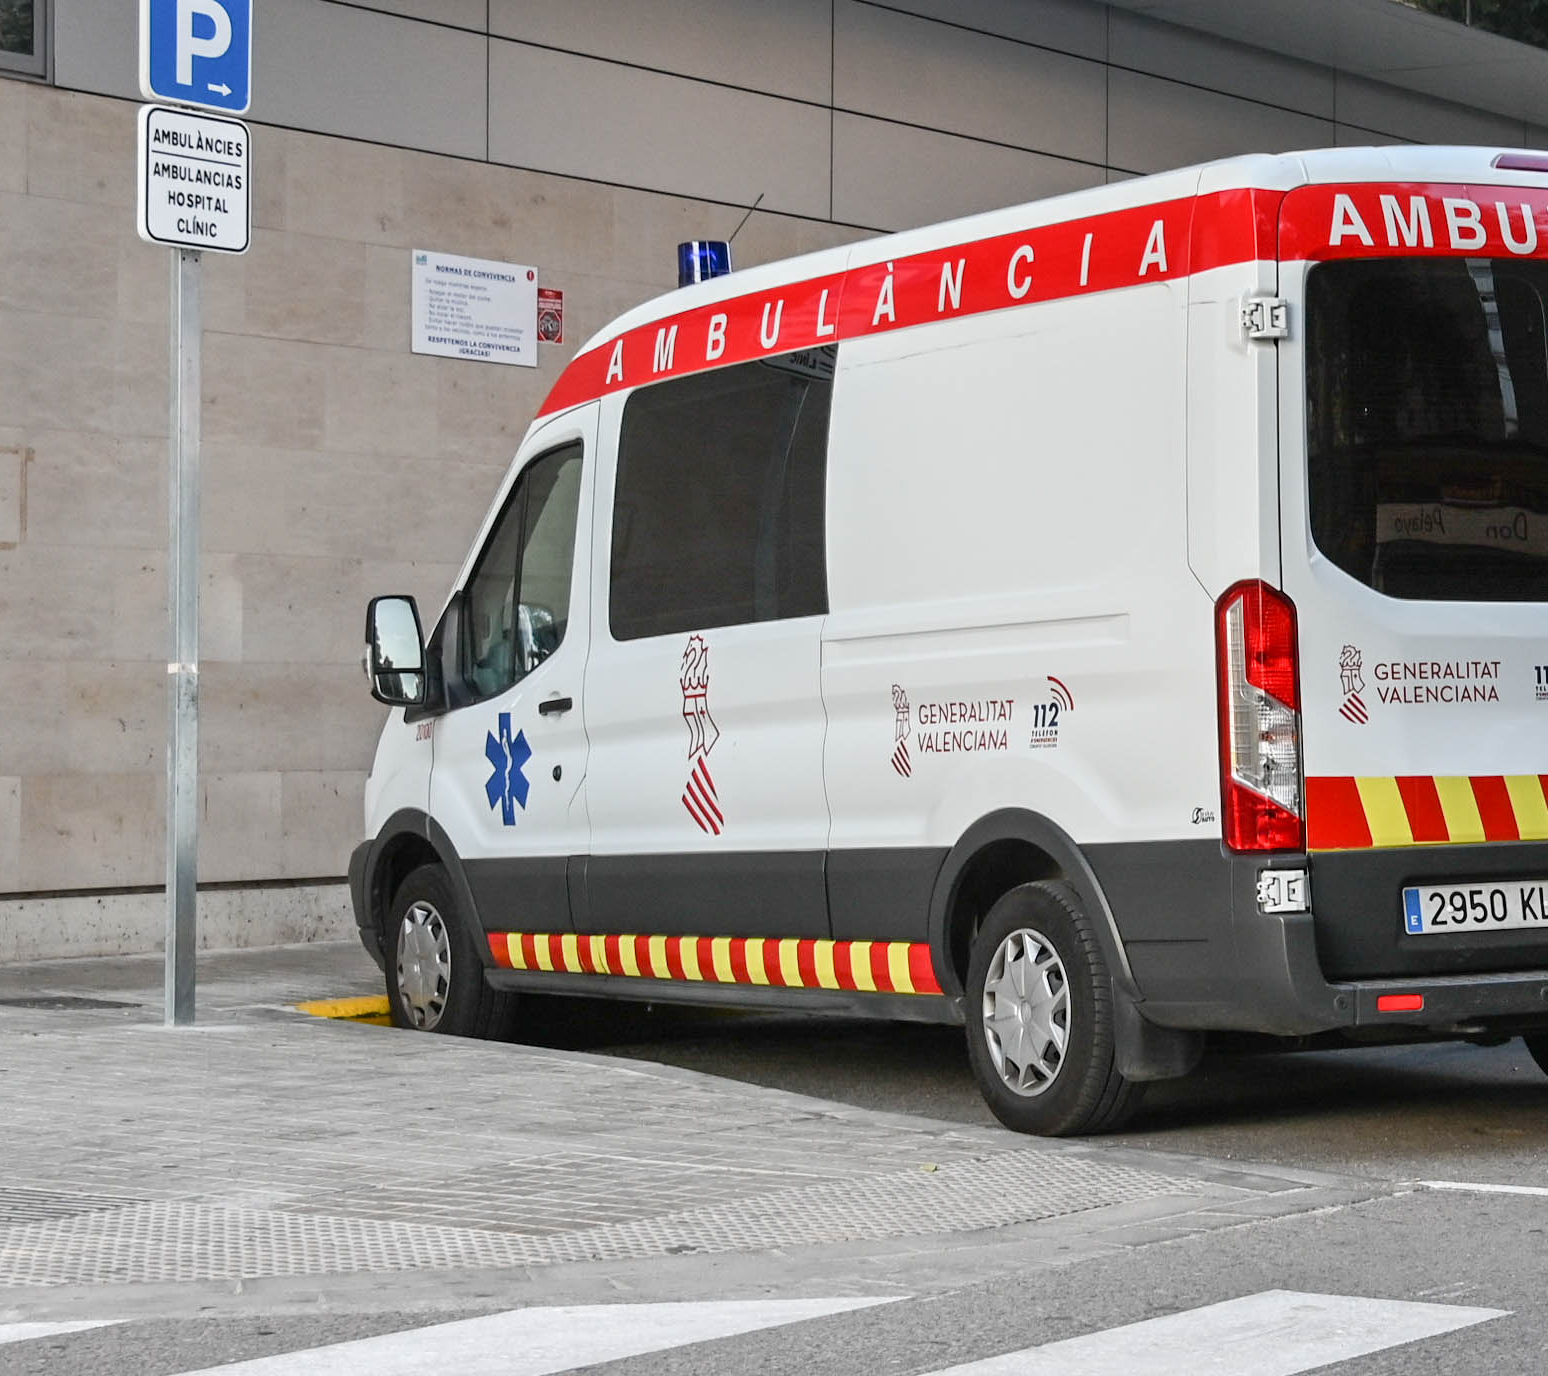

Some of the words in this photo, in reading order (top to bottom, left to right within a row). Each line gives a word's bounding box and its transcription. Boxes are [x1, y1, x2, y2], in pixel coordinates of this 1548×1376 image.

[153, 128, 243, 157] AMBULÀNCIES
[153, 162, 242, 190] AMBULANCIAS
[168, 190, 228, 213] HOSPITAL
[177, 215, 217, 237] CLÍNIC
[435, 264, 462, 275] NORMAS
[463, 268, 471, 276] DE
[473, 270, 516, 282] CONVIVENCIA
[605, 219, 1169, 385] AMBULÀNCIA
[428, 335, 468, 346] RESPETEMOS
[478, 342, 521, 352] CONVIVENCIA
[1374, 661, 1501, 681] GENERALITAT
[1376, 685, 1500, 704] VALENCIANA
[917, 699, 1015, 724] GENERALITAT
[1033, 702, 1059, 728] 112
[917, 729, 1009, 753] VALENCIANA
[1429, 888, 1508, 926] 2950
